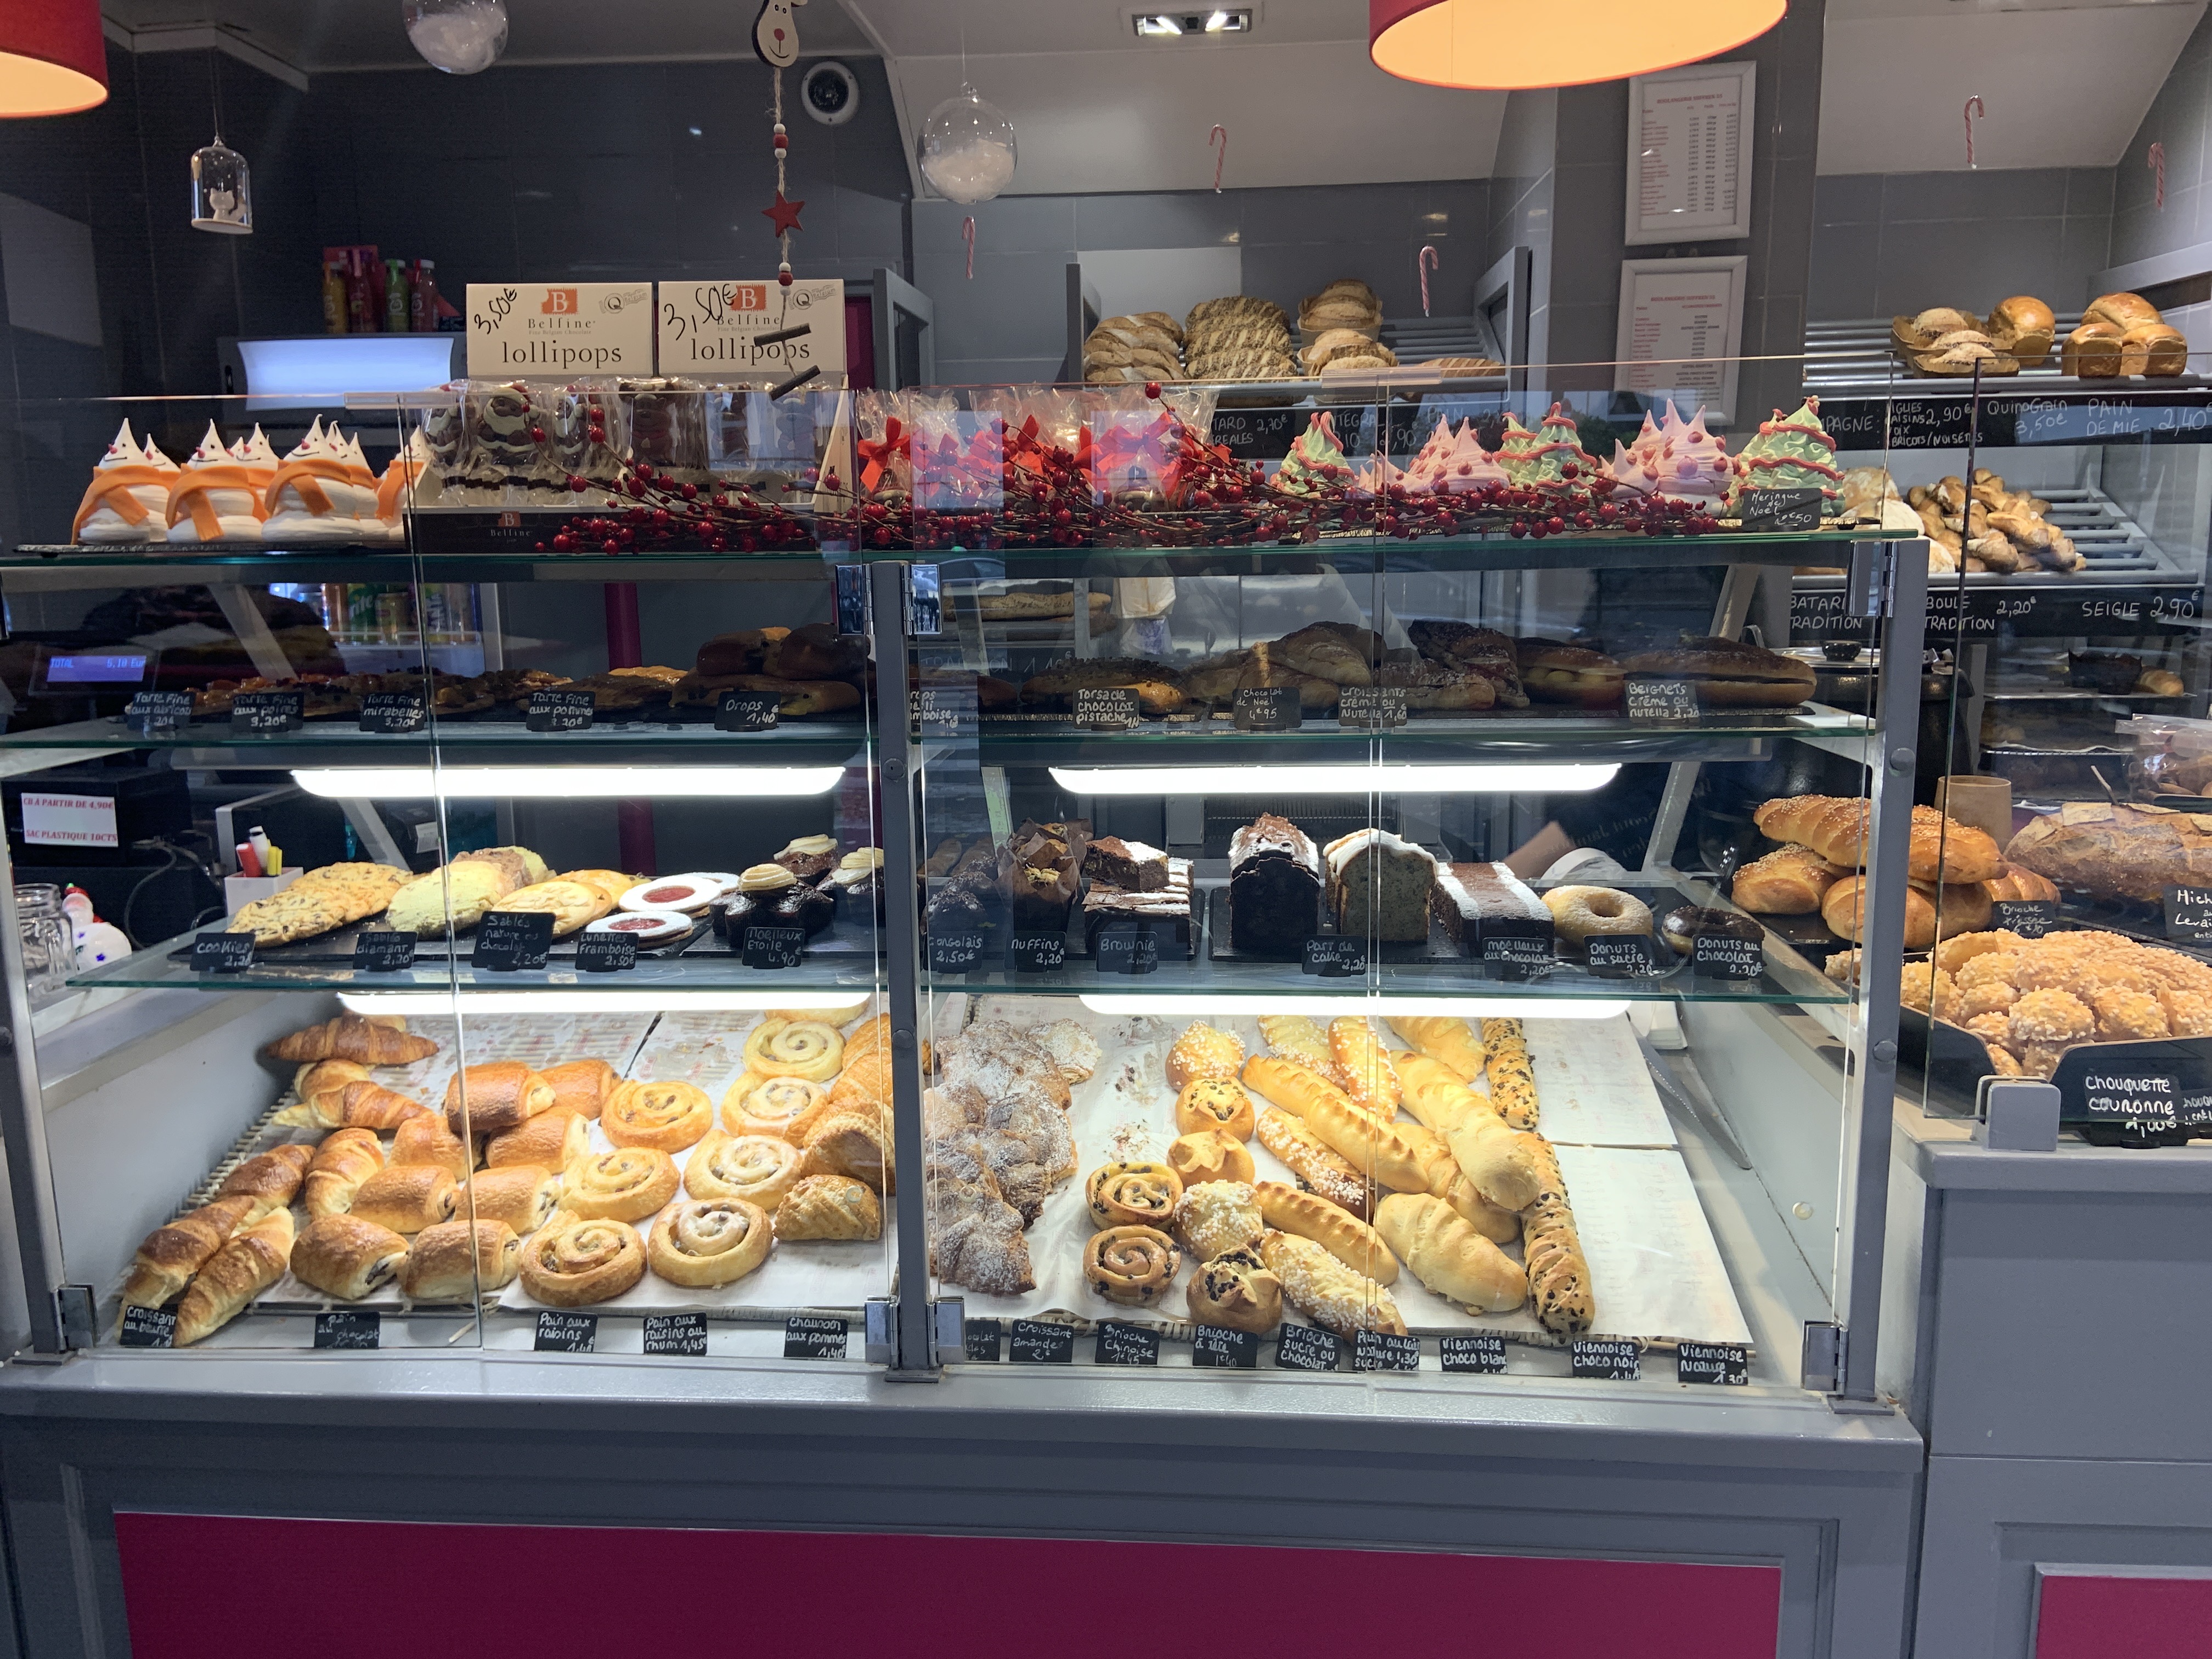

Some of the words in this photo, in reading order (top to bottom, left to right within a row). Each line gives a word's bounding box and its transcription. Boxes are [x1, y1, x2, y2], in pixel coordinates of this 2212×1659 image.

[552, 292, 567, 312] B
[741, 288, 756, 309] B
[528, 318, 591, 328] Belfine
[718, 314, 780, 325] Belfine
[503, 340, 622, 369] lollipops
[691, 336, 810, 366] lollipops
[2088, 399, 2132, 415] PAIN
[2087, 421, 2105, 436] DE
[491, 529, 531, 537] Belfine
[50, 658, 74, 668] TOTAL
[726, 699, 763, 713] Drops
[42, 799, 73, 807] PARTIR
[26, 830, 40, 838] SAC
[42, 831, 88, 840] PLASTIQUE
[1590, 956, 1606, 966] au
[124, 1321, 138, 1330] au
[1018, 1322, 1072, 1339] Croissant
[786, 1331, 806, 1341] aux
